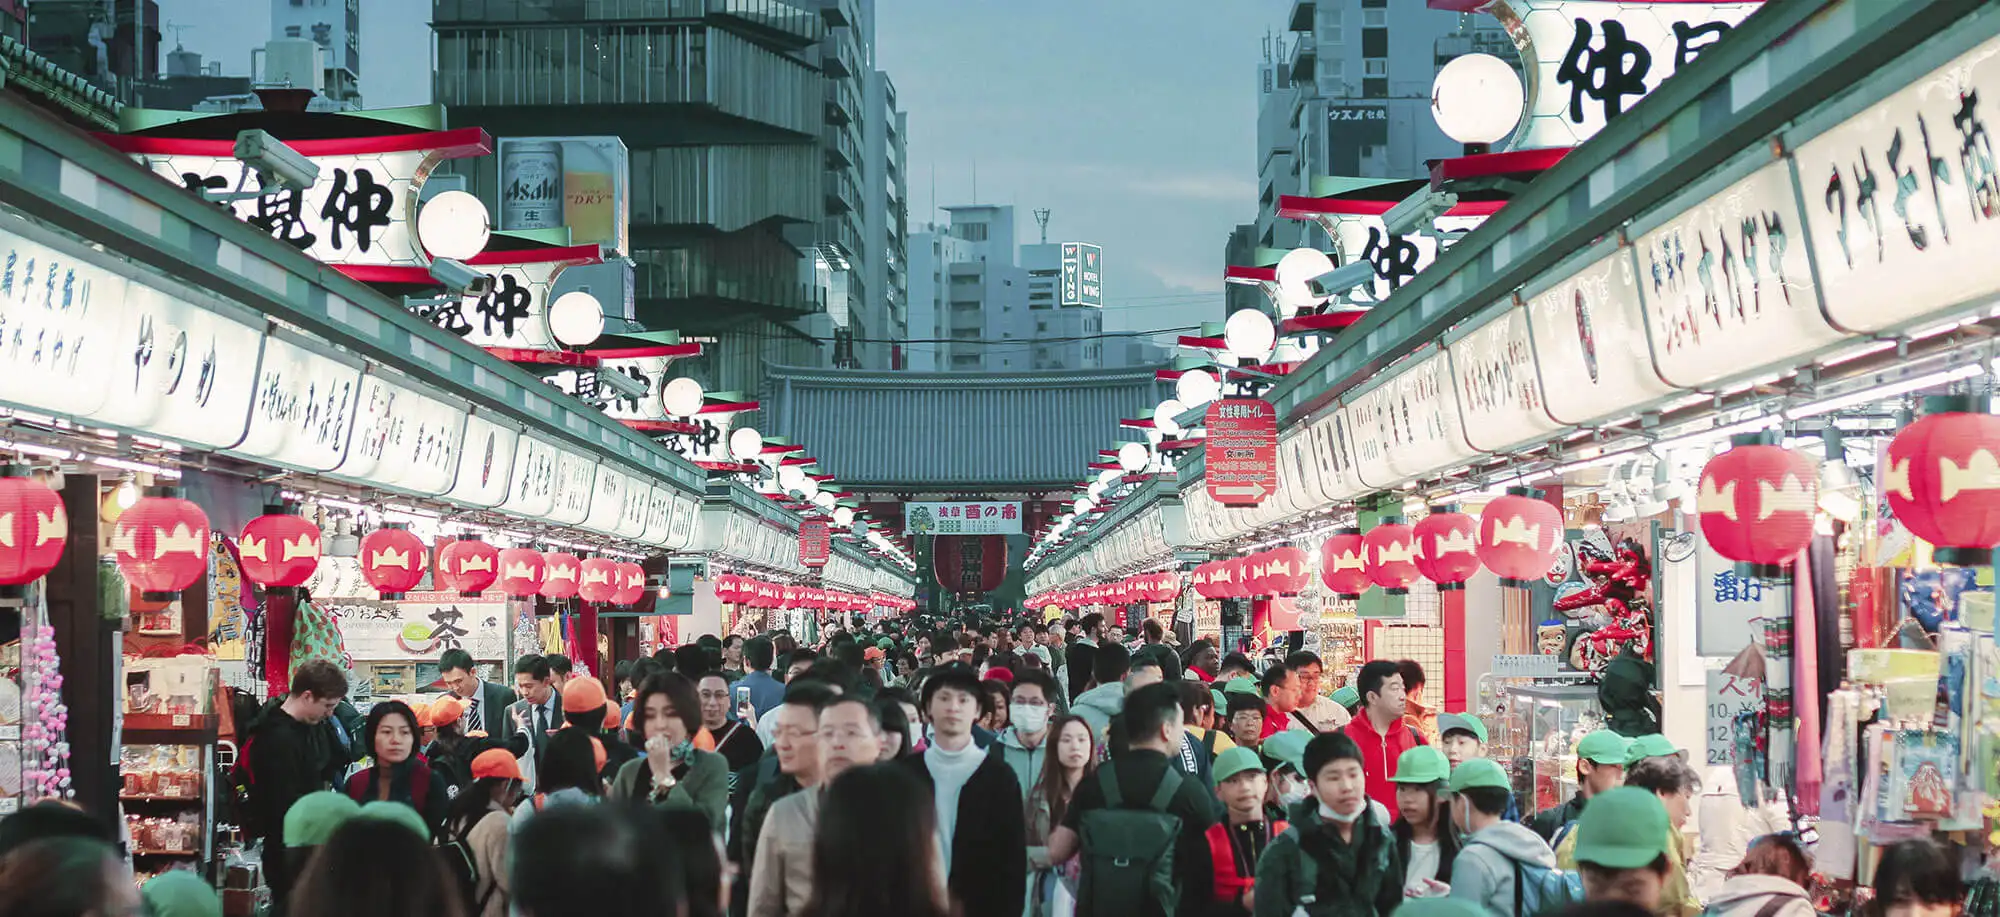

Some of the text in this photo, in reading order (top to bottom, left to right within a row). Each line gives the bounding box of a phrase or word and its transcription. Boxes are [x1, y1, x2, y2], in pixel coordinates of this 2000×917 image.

[505, 177, 559, 200] Asahi
[524, 210, 541, 221] 生
[1065, 264, 1076, 299] WING
[1083, 271, 1099, 283] HOTEL
[1082, 284, 1100, 298] WING
[1219, 404, 1264, 418] 女性専用トイレ
[964, 503, 1017, 519] 酉の市
[428, 604, 470, 648] 茶
[1708, 703, 1728, 718] 10
[1708, 726, 1728, 741] 12
[1708, 749, 1727, 764] 24
